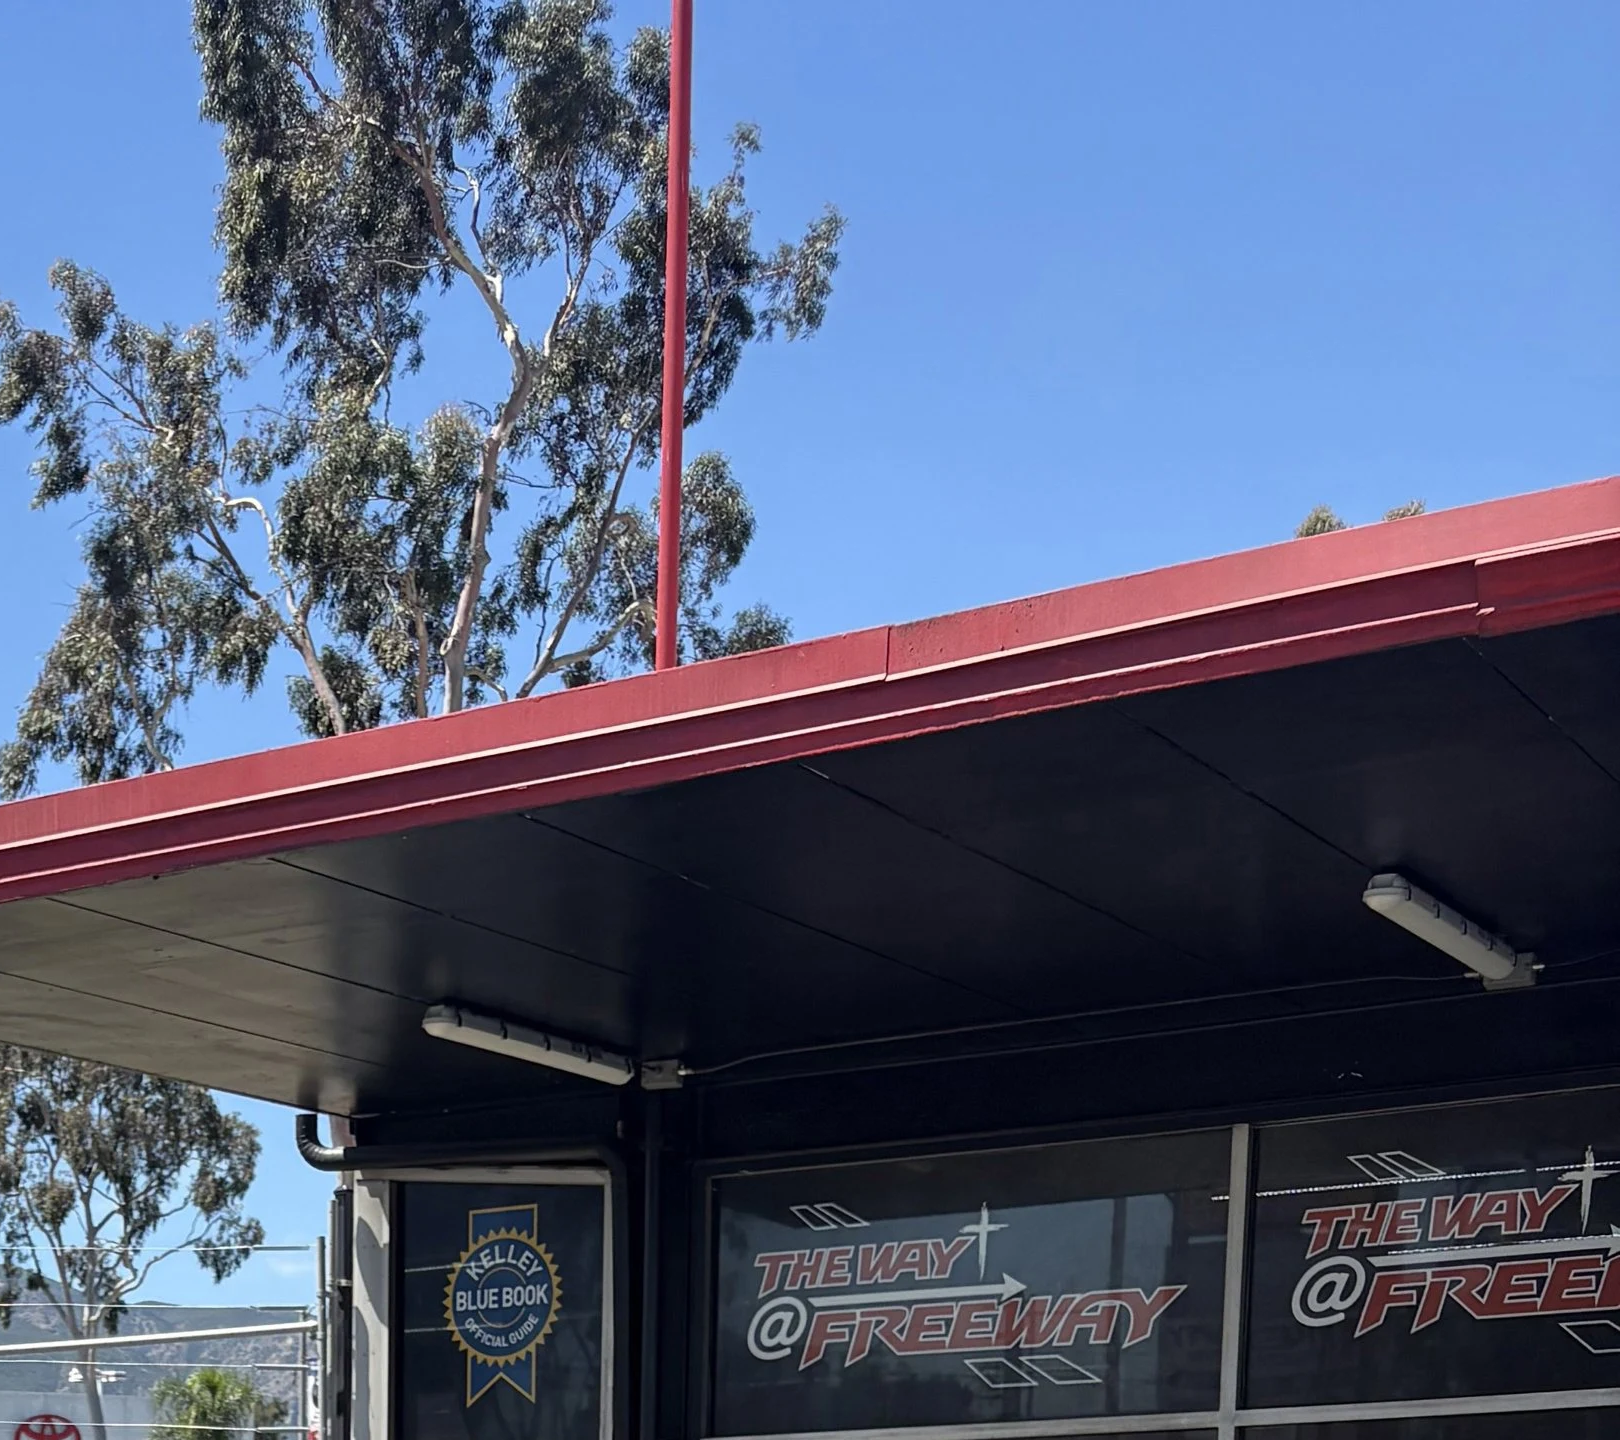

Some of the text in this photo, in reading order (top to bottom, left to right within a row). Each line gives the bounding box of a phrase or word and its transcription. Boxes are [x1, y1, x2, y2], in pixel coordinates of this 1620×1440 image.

[465, 1244, 544, 1282] KELLEY
[455, 1283, 549, 1312] BLUE BOOK
[464, 1312, 540, 1348] OFFICIAL GUIDE
